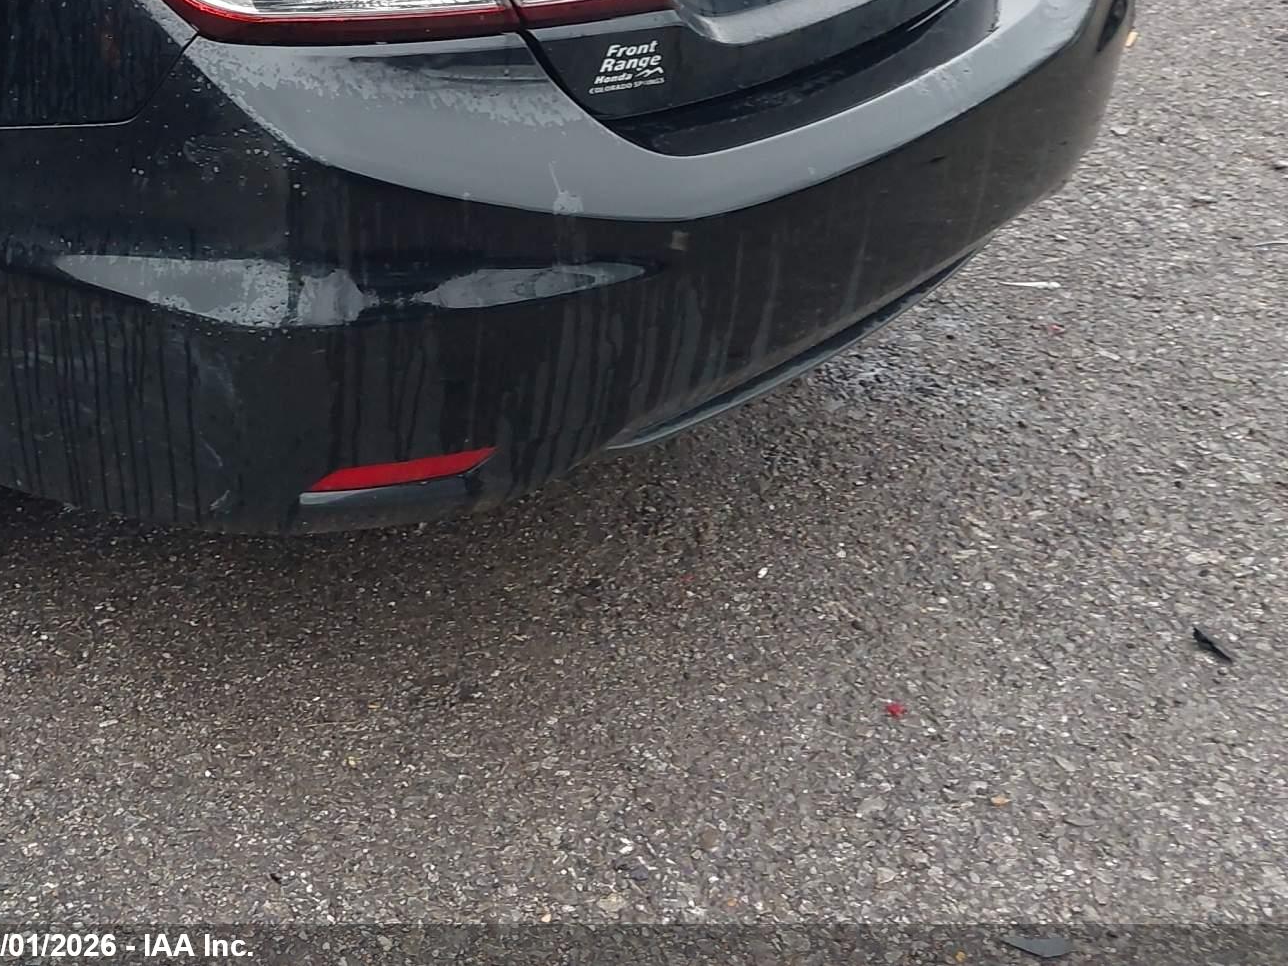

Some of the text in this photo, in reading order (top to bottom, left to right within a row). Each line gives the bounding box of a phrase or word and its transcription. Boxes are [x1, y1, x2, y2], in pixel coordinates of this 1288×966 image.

[606, 40, 658, 57] Front
[599, 55, 662, 73] Range
[593, 73, 633, 84] Honda
